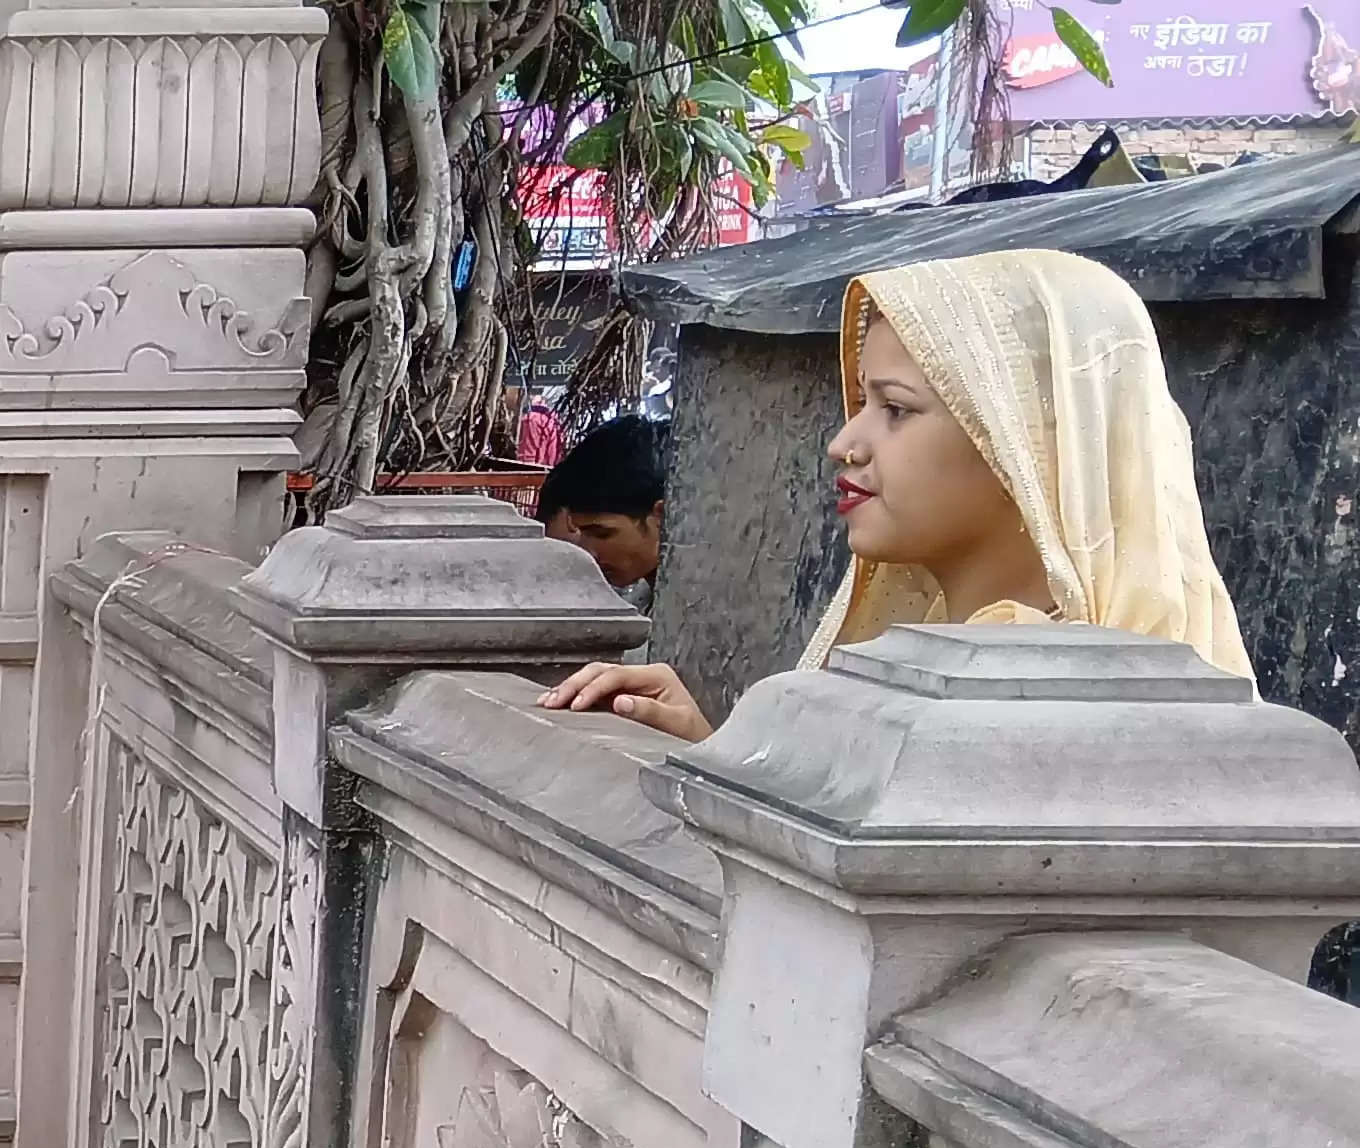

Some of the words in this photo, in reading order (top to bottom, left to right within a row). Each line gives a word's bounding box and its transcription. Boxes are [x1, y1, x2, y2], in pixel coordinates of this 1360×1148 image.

[1129, 24, 1150, 40] नए
[1154, 15, 1229, 51] इंडिया
[1236, 22, 1272, 43] का
